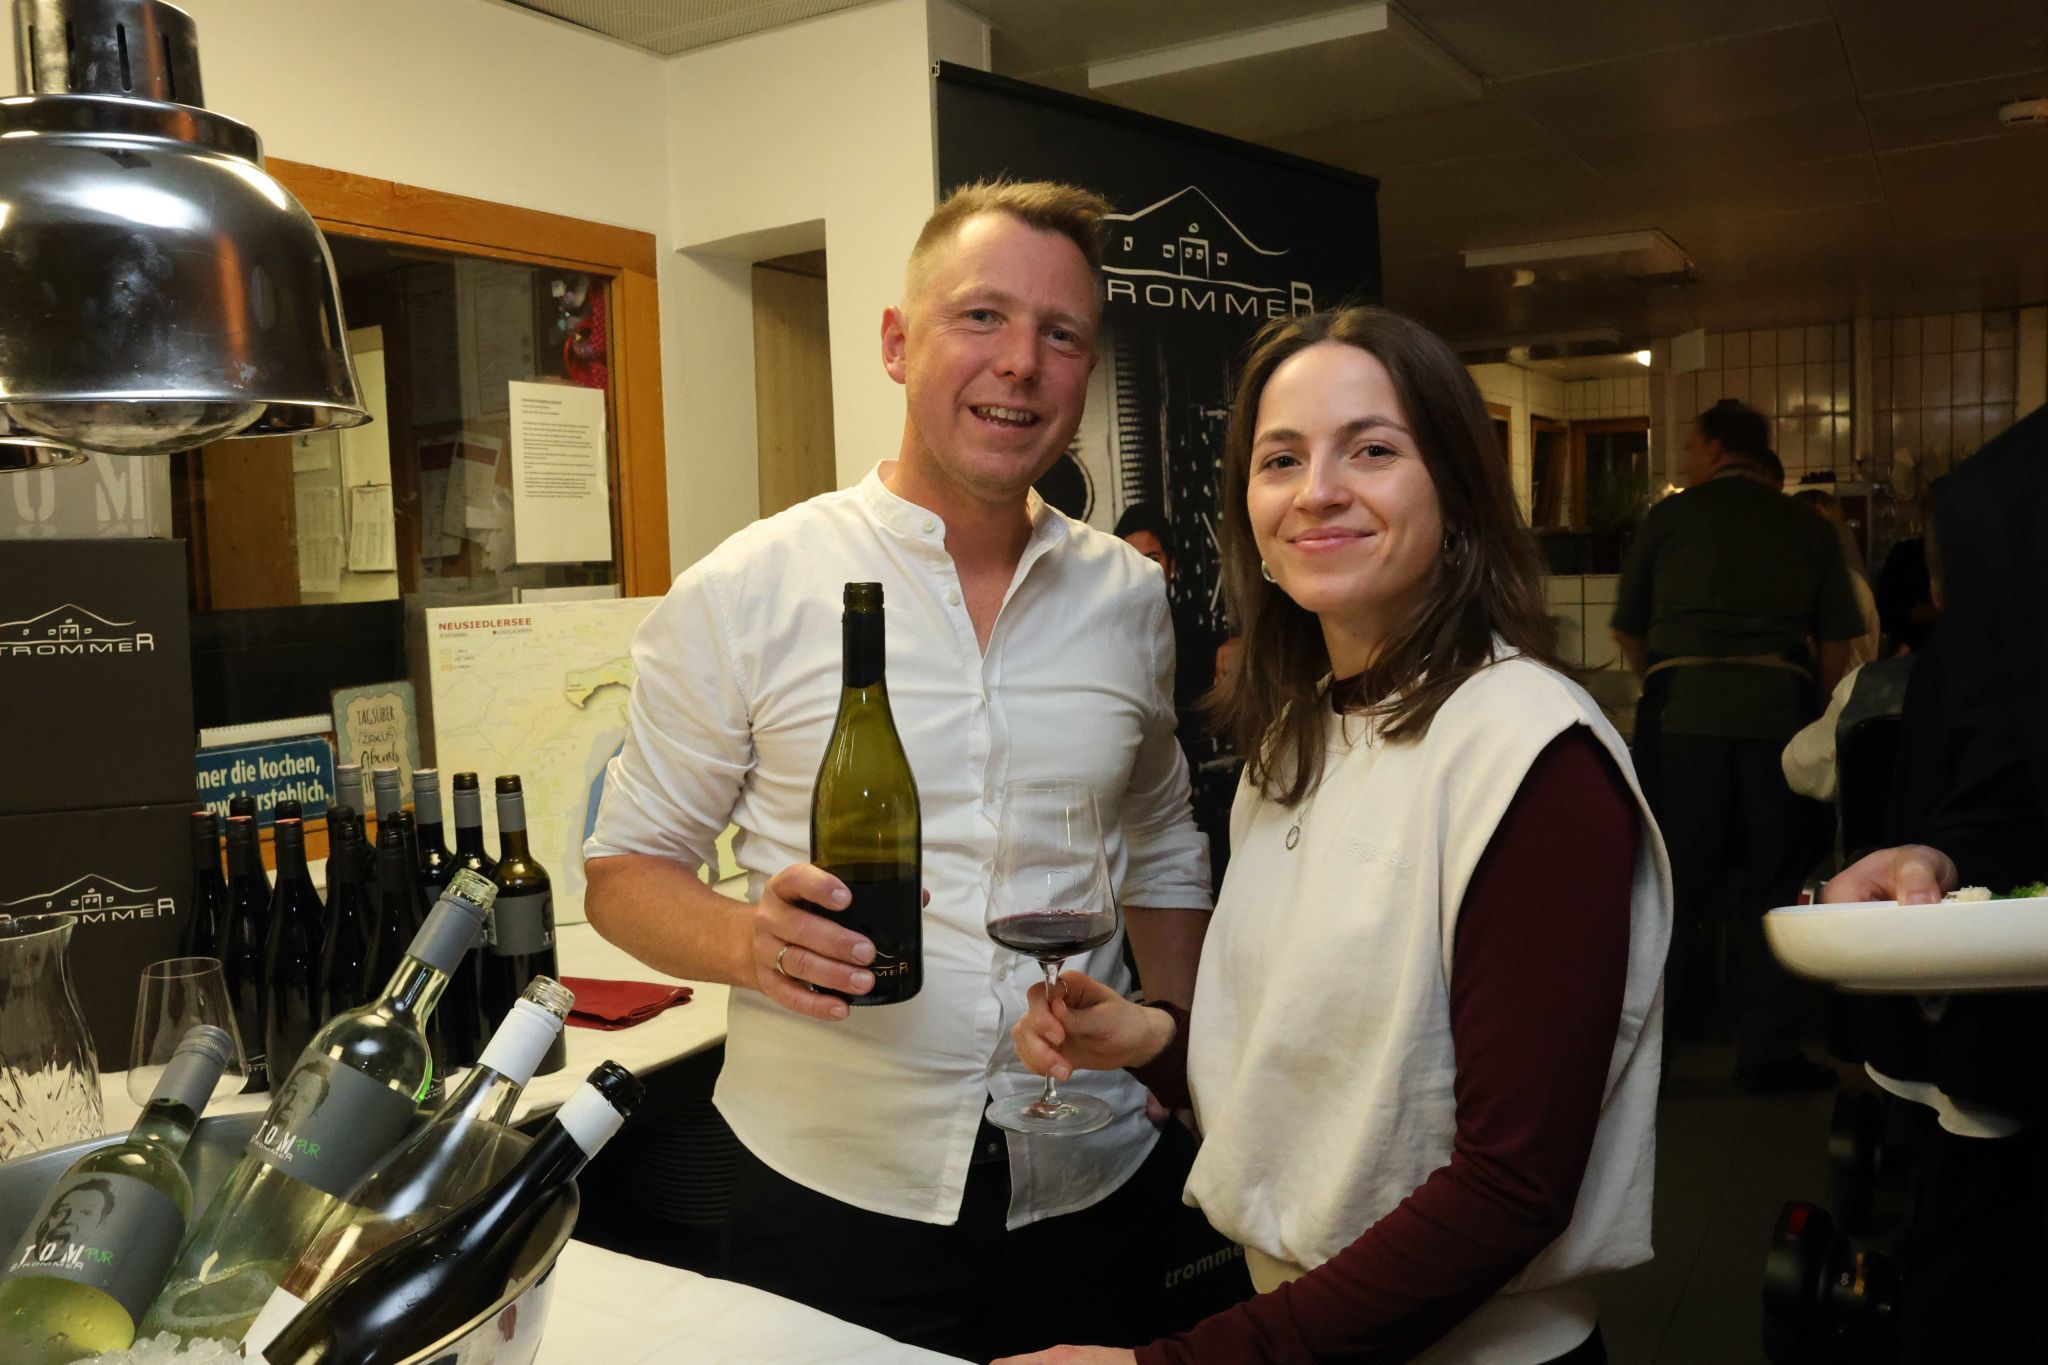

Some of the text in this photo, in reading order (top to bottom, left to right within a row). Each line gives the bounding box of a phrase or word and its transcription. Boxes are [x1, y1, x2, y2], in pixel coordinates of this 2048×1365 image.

[438, 617, 532, 631] NEUSIEDLERSEE
[197, 753, 321, 790] ner die kochen,
